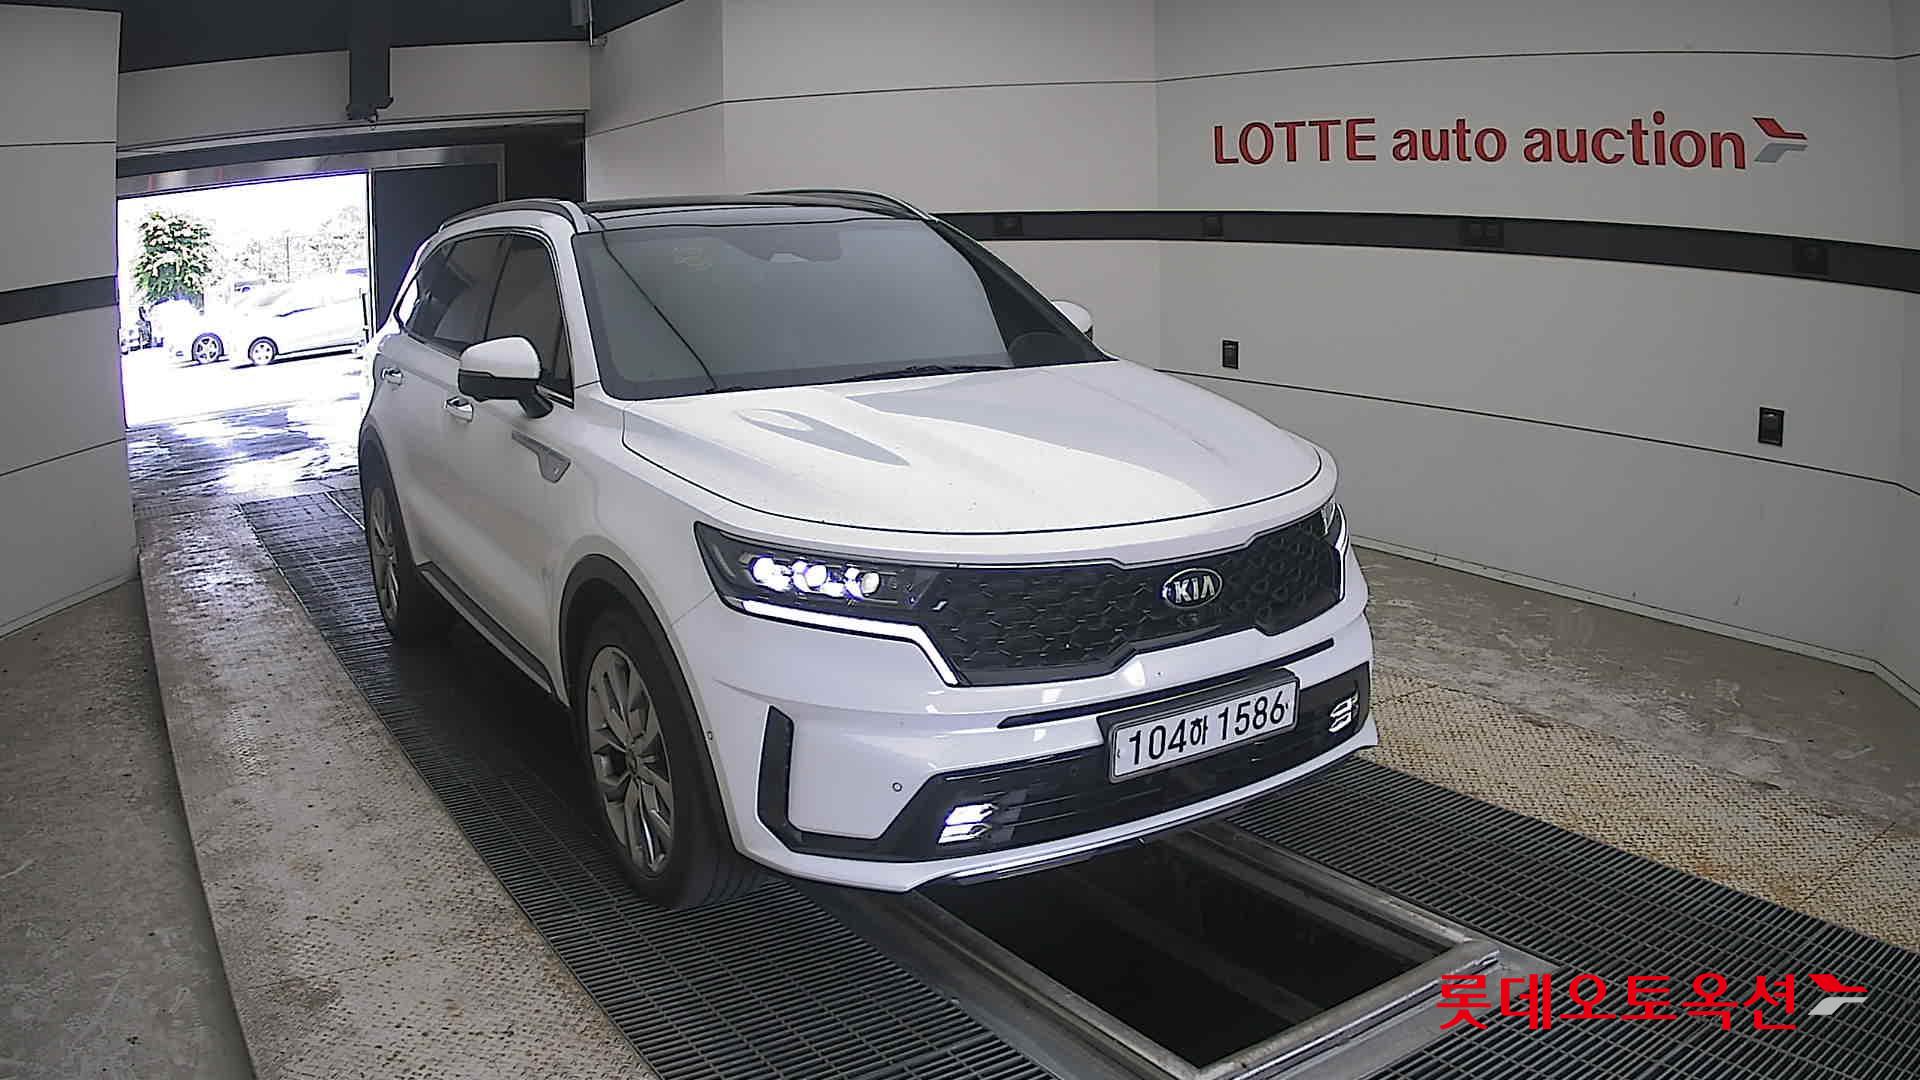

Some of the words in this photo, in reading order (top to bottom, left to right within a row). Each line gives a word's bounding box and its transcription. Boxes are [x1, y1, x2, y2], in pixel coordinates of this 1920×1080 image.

[1213, 118, 1377, 165] LOTTE
[1392, 118, 1508, 163] auto
[1523, 111, 1746, 170] auction
[1173, 575, 1216, 603] KIA
[1128, 715, 1209, 766] 104하
[1217, 690, 1286, 741] 1586
